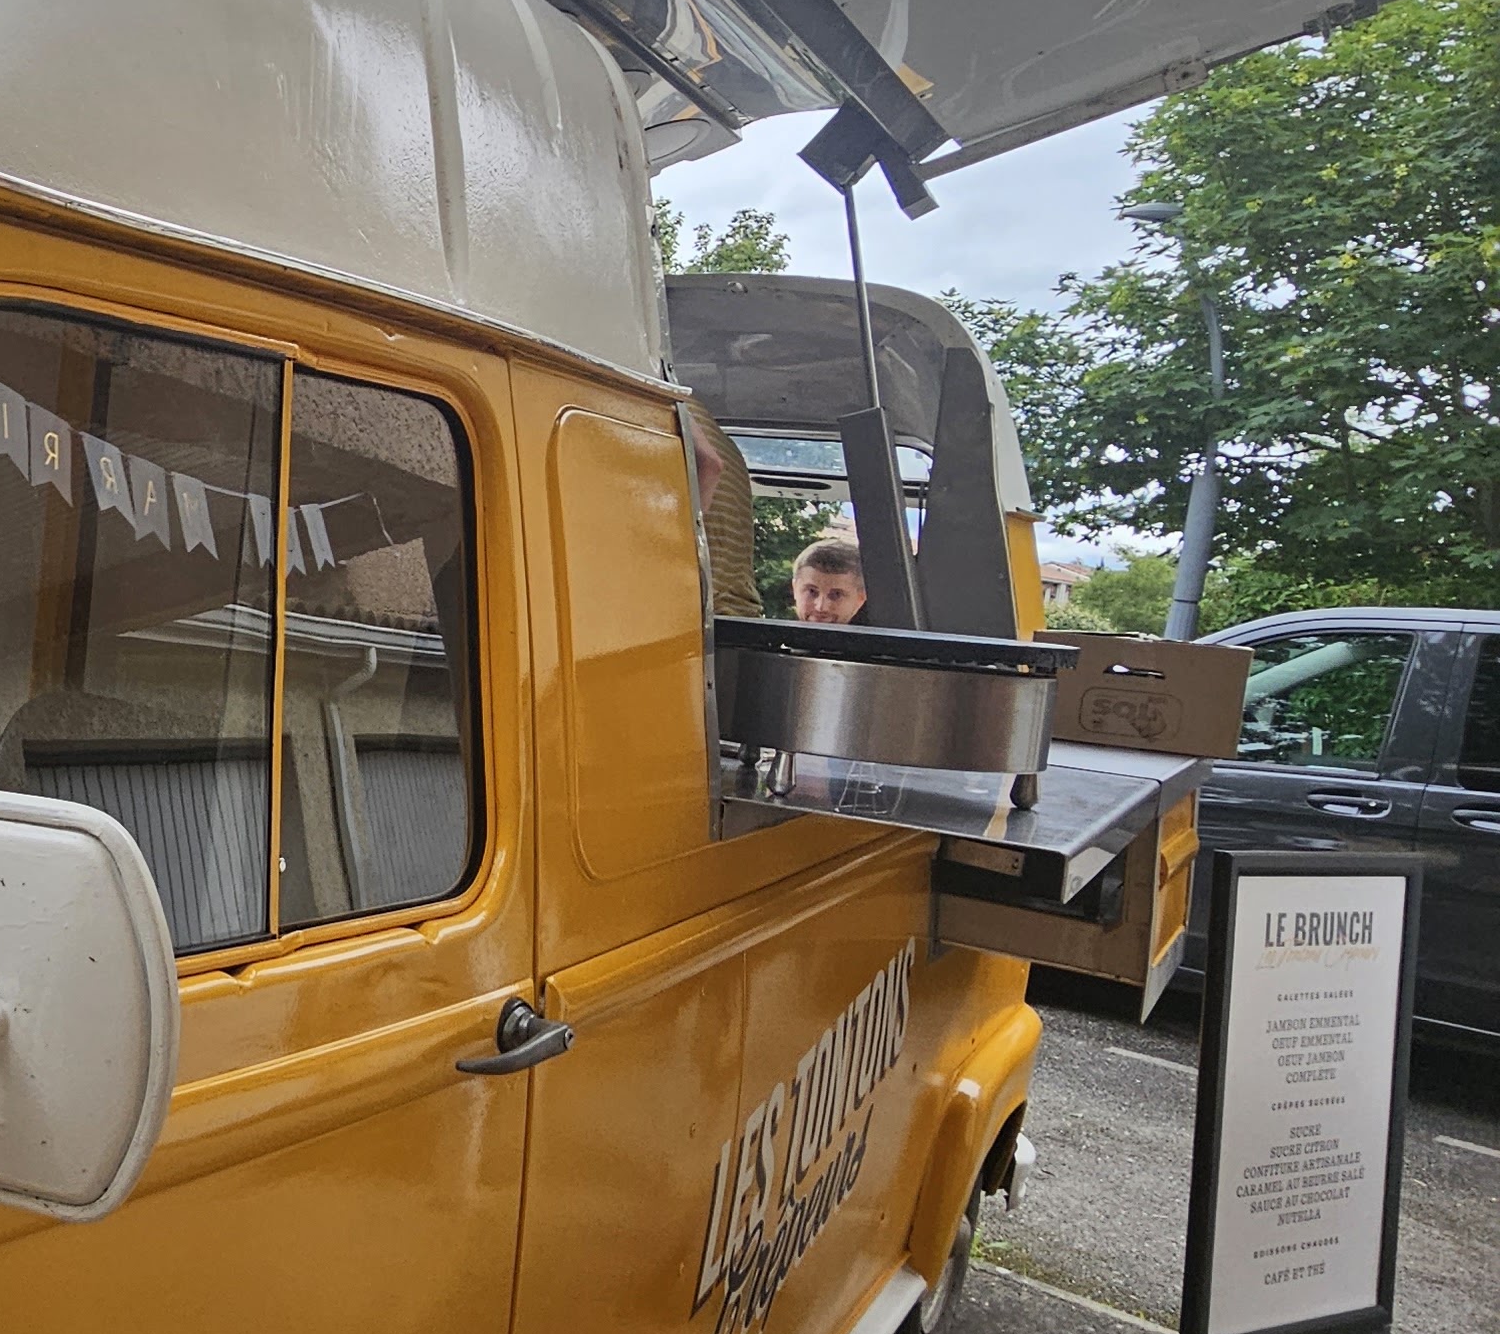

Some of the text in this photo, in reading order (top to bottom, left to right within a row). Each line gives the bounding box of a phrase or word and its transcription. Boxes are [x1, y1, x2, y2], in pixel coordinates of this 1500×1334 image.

[1264, 911, 1374, 948] LE BRUNCH
[1266, 1014, 1361, 1034] JAMBON EMMENTAL
[1271, 1031, 1354, 1050] OEUF EMMENTAL
[1277, 1049, 1346, 1067] OEUF JAMBON
[689, 935, 916, 1321] LES TONTONS
[1304, 1138, 1340, 1154] CITRON
[1243, 1151, 1362, 1179] CONFITURE ARTISANALE
[1236, 1180, 1284, 1198] CARAMEL
[1285, 1177, 1300, 1191] AU
[1250, 1186, 1351, 1214] SAUCE AU CHOCOLAT
[1277, 1208, 1322, 1226] NUTELLA
[1292, 1266, 1305, 1280] ET
